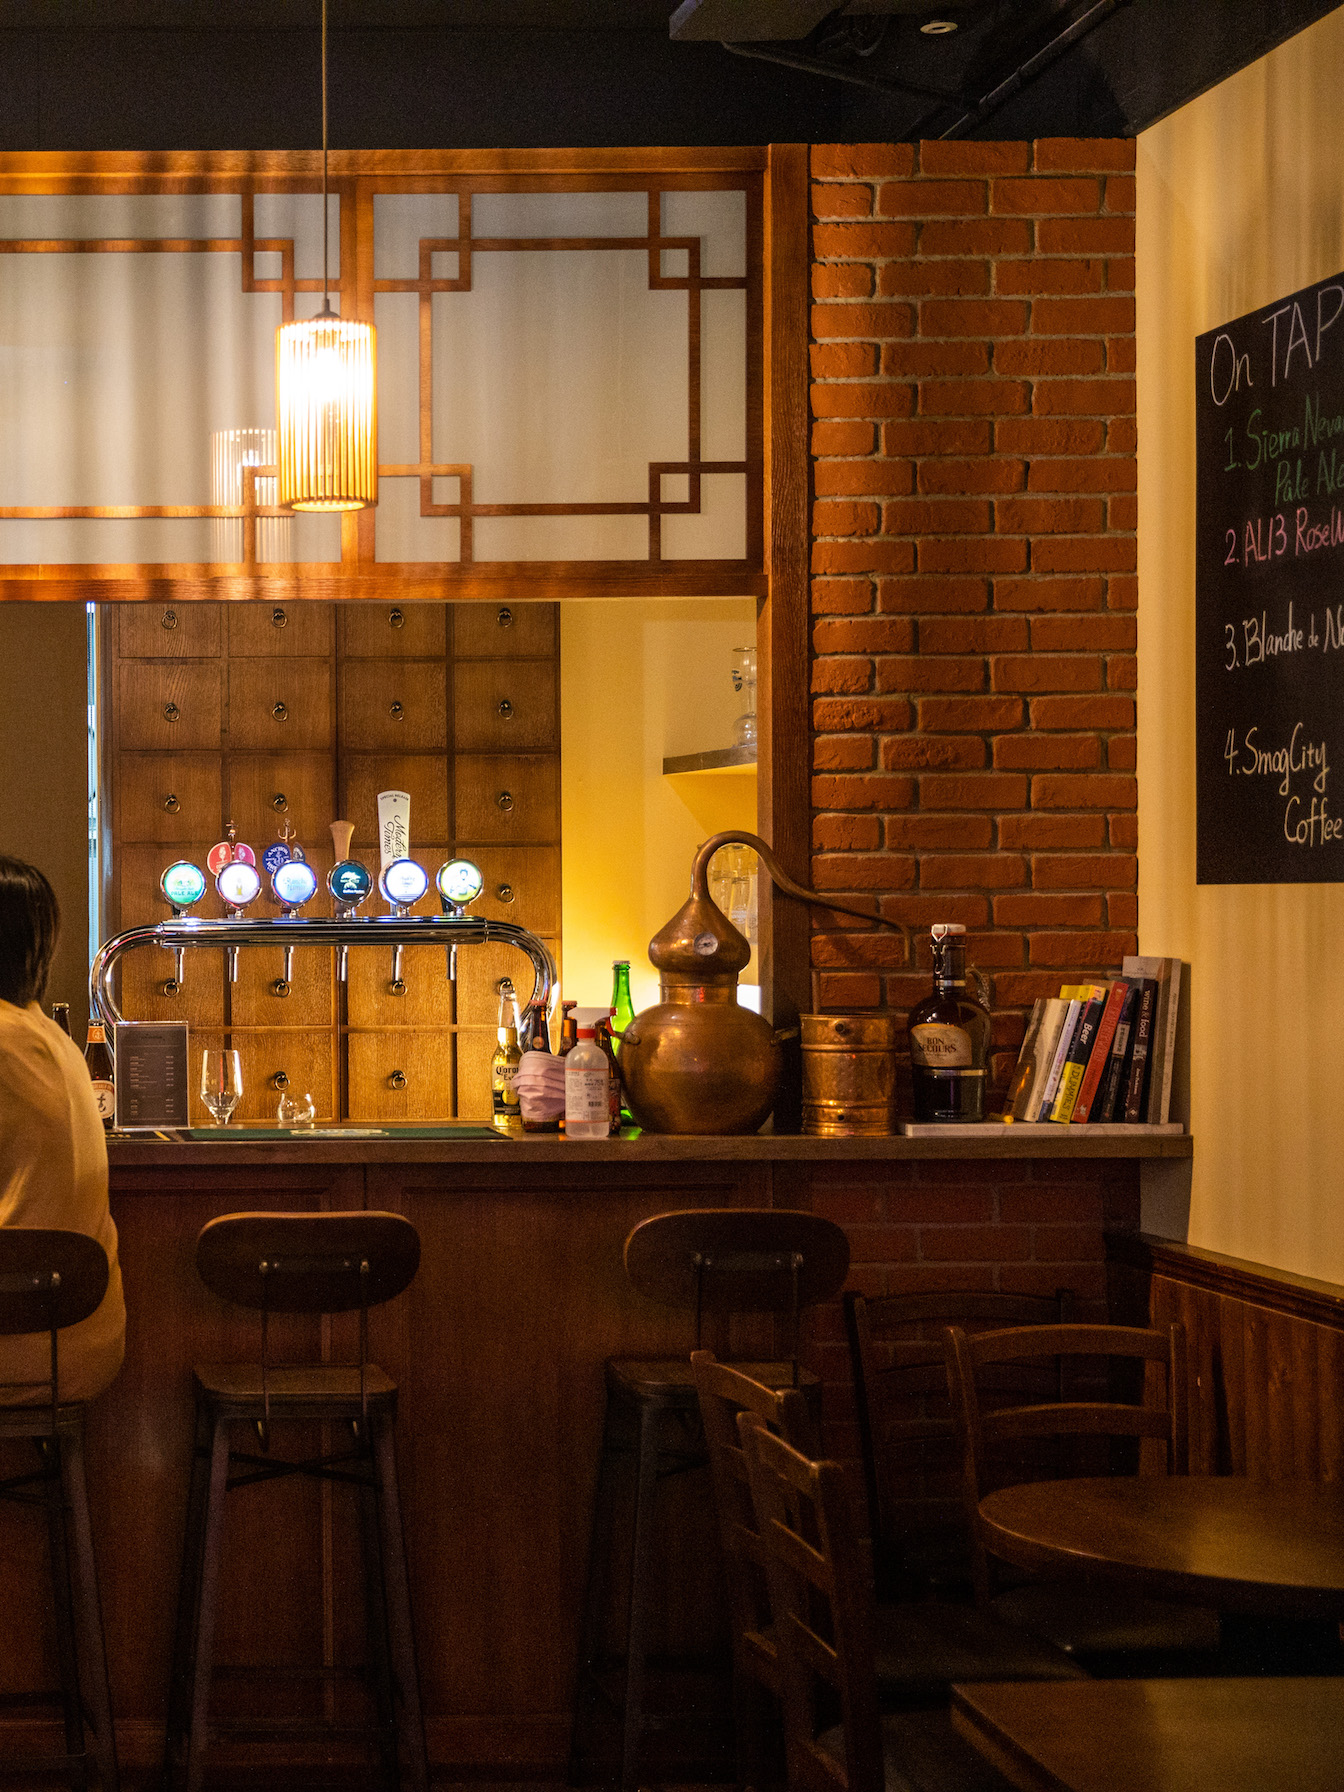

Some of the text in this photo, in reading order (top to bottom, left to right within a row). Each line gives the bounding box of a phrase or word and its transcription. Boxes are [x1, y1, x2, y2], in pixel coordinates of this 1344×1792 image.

[1211, 334, 1253, 405] On
[1246, 408, 1300, 470] Sierra
[1275, 460, 1309, 506] Pale
[1242, 601, 1304, 666] Blanche
[1284, 796, 1344, 848] Coffee
[1141, 990, 1151, 1011] wine
[1080, 1022, 1093, 1045] Beer
[1139, 1018, 1150, 1038] food
